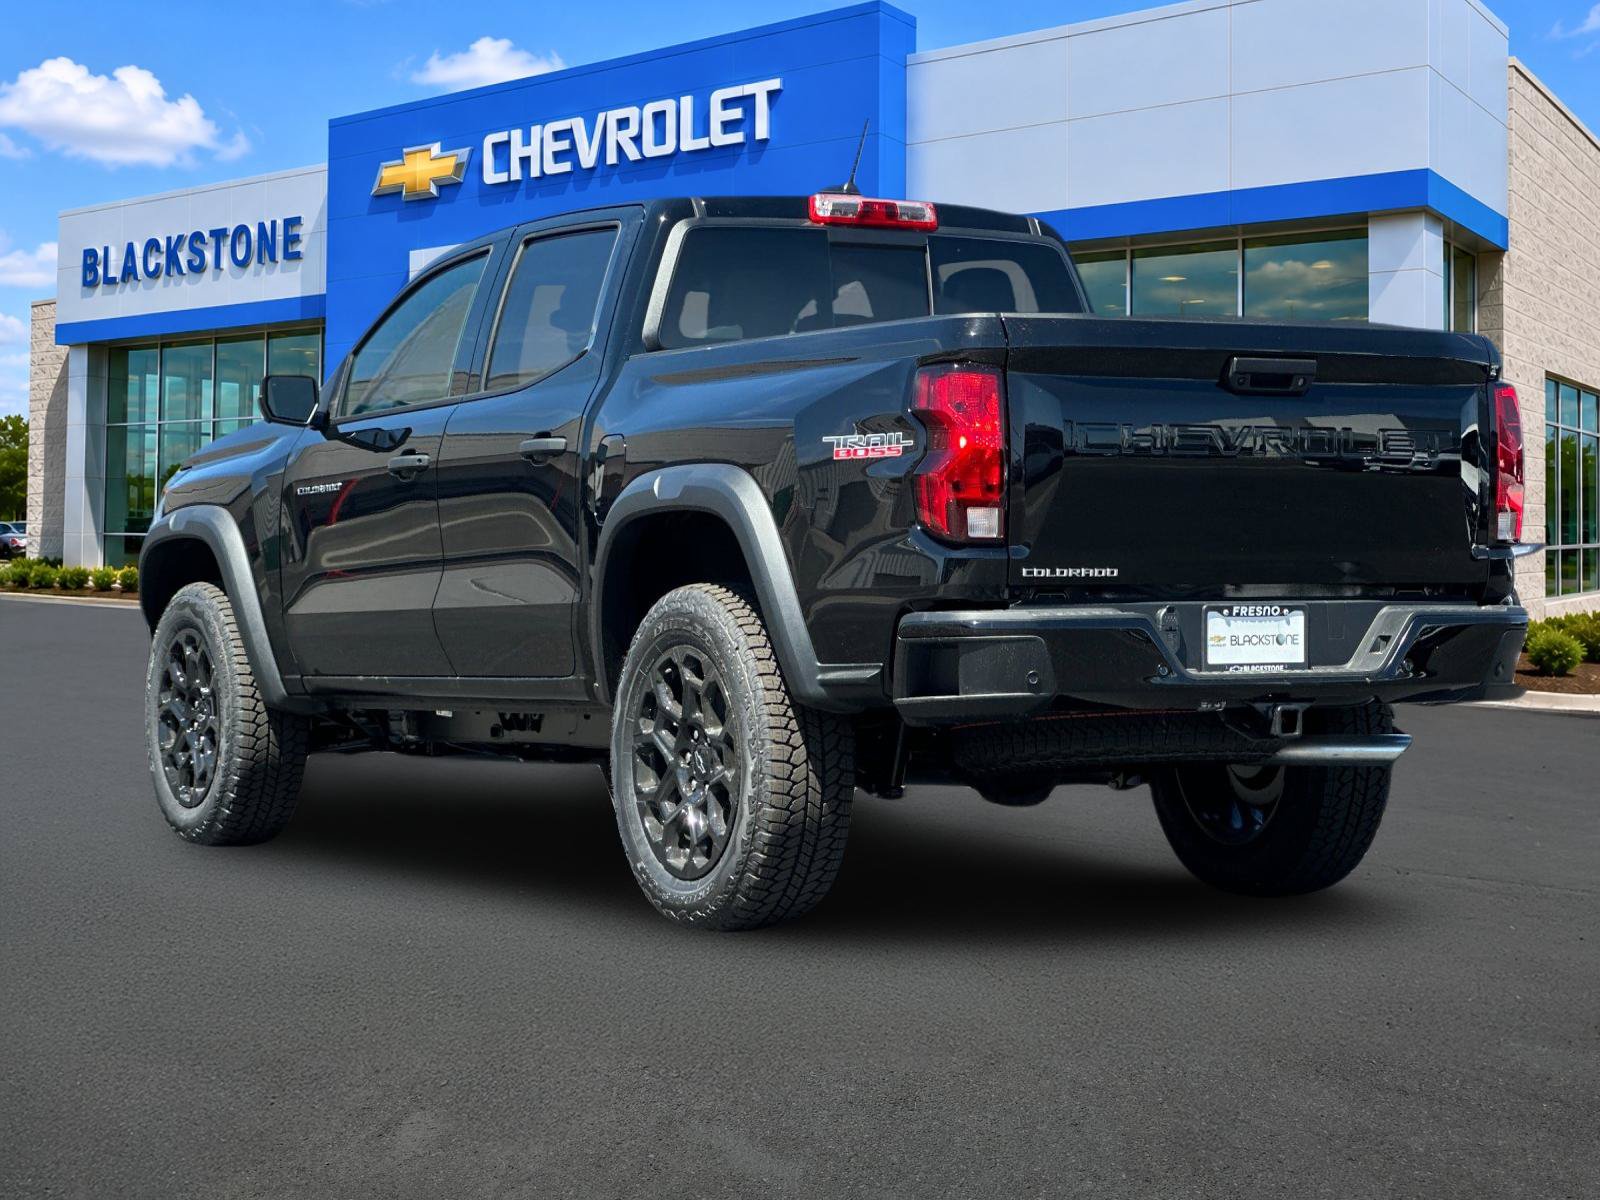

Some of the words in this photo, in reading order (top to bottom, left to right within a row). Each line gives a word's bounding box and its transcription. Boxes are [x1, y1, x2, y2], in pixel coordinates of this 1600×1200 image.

[483, 78, 783, 185] CHEVROLET
[82, 216, 303, 287] BLACKSTONE
[822, 432, 913, 449] TRAIL
[834, 446, 902, 460] BOSS
[1022, 567, 1119, 577] COLORADO
[1232, 606, 1281, 616] FRESNO
[1230, 634, 1299, 646] BLACKSTONE
